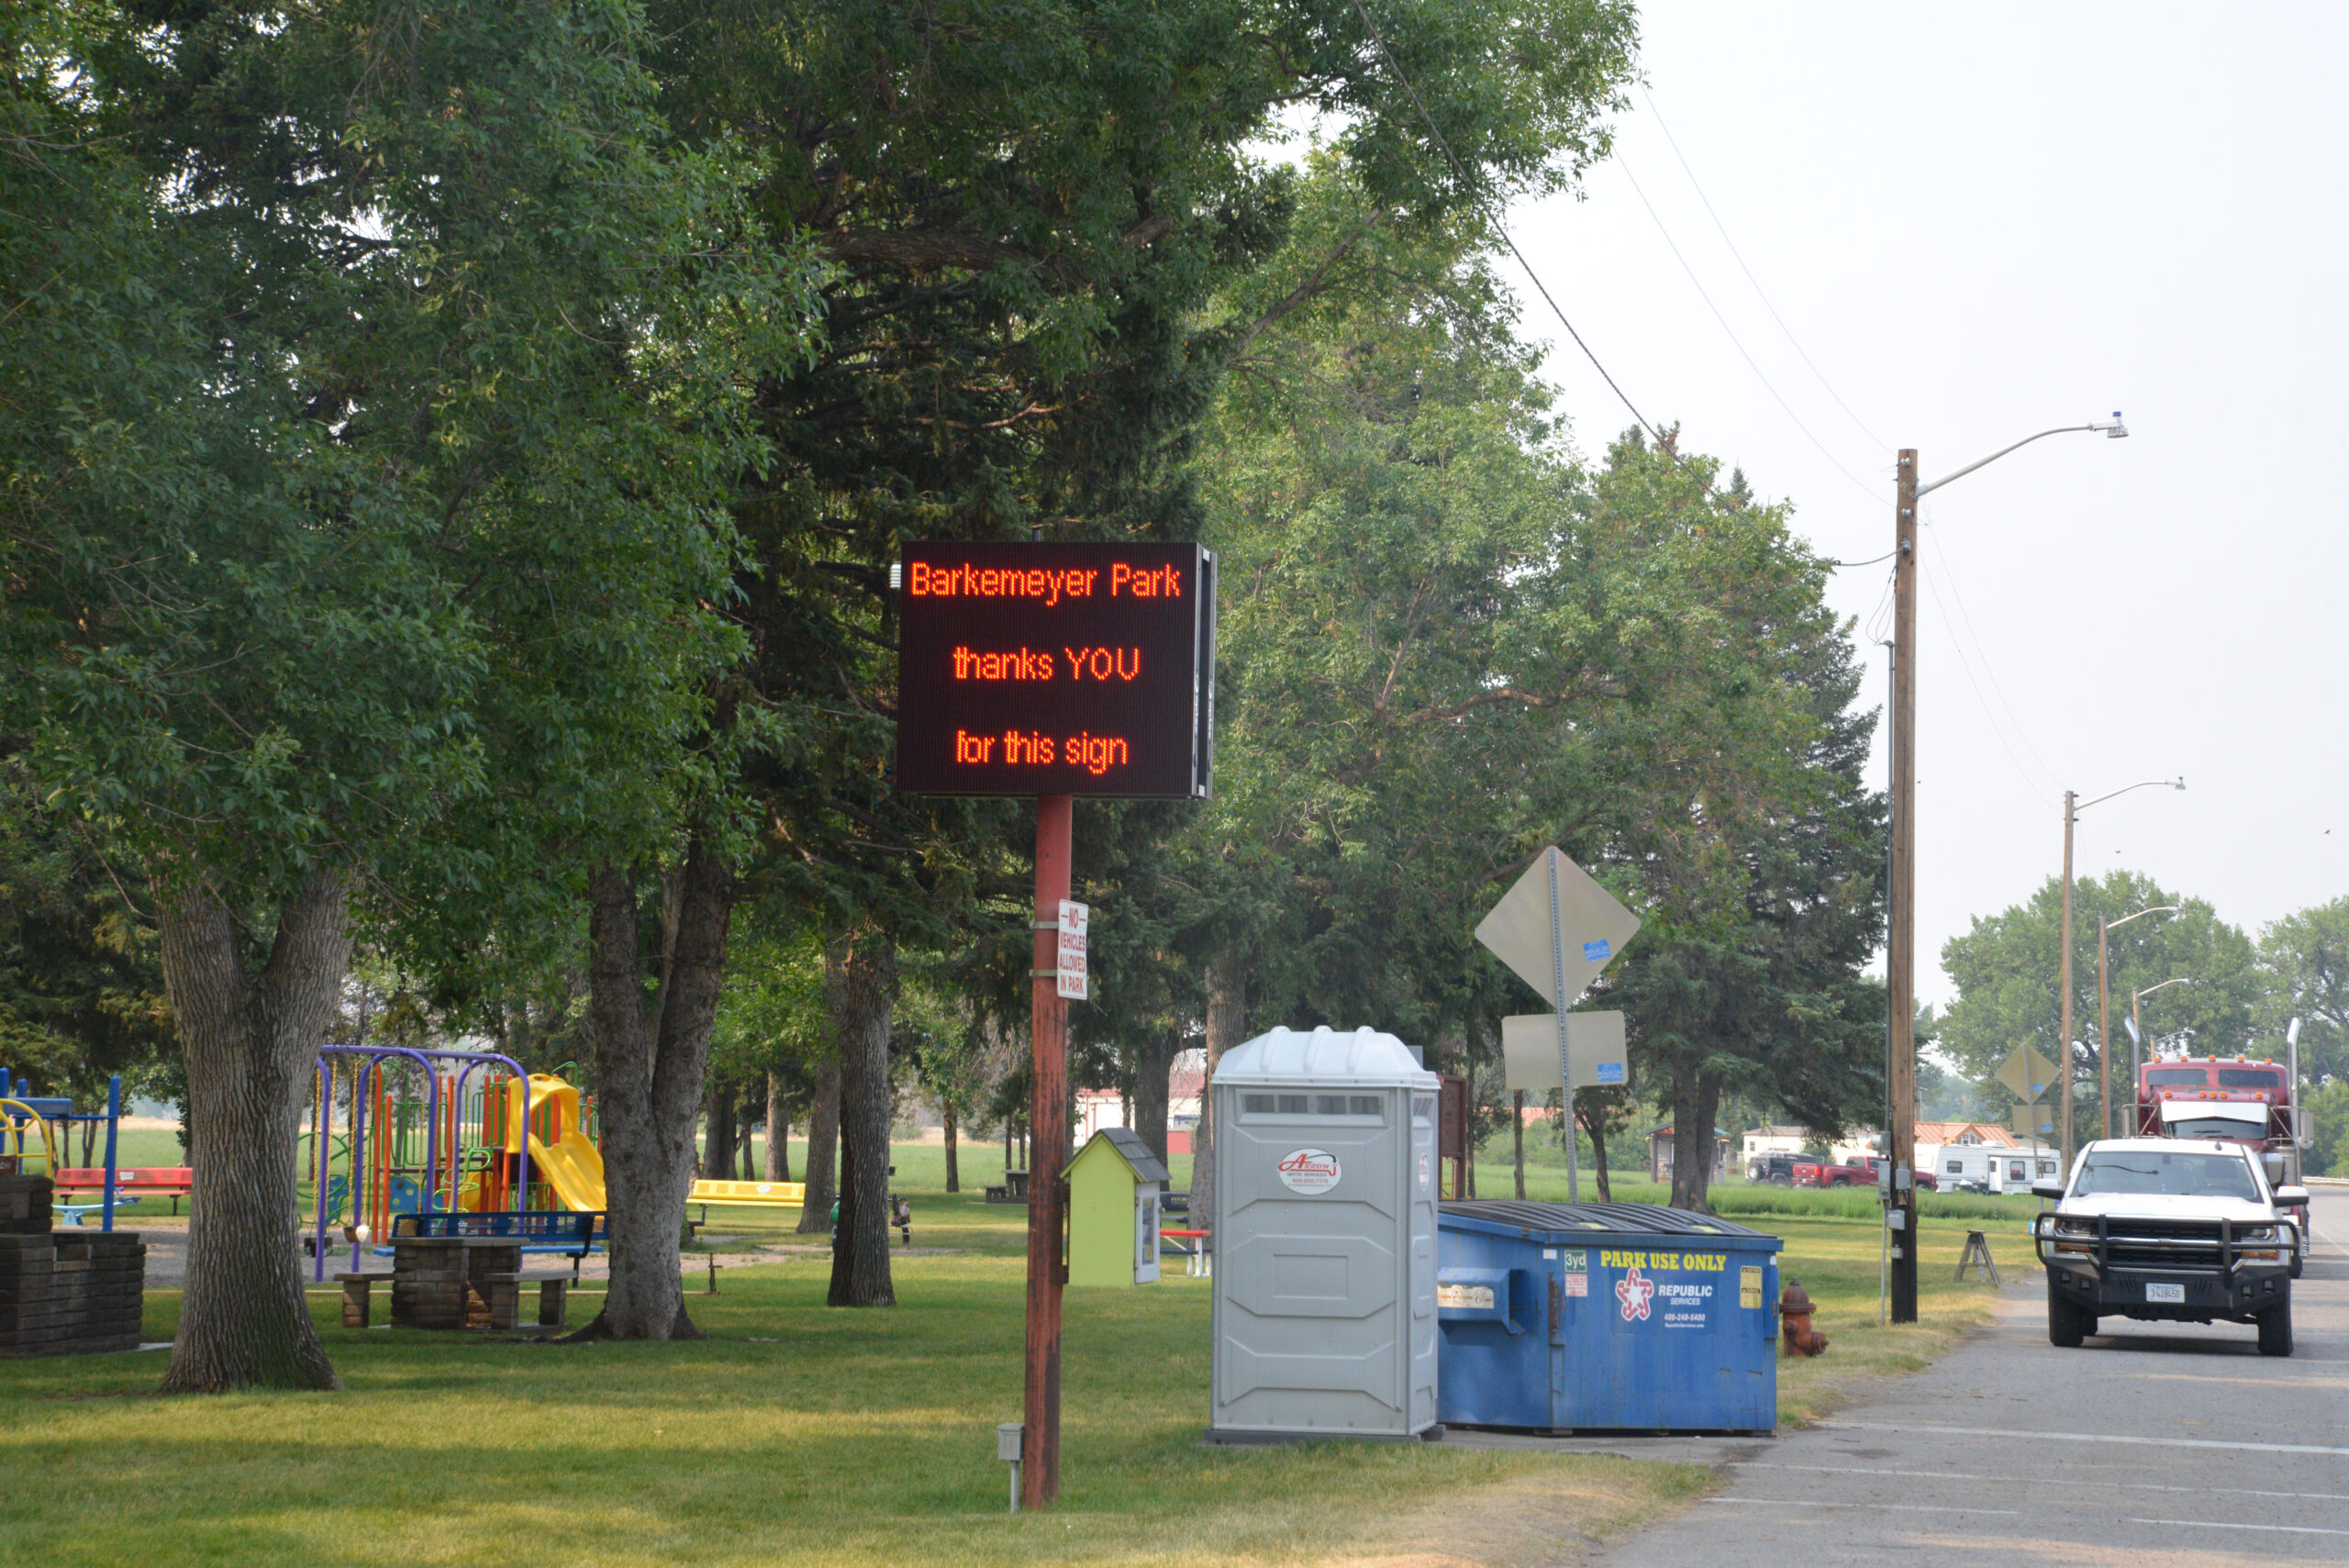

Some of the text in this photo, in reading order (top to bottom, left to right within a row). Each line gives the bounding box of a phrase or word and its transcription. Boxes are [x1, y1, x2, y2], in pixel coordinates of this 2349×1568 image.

[910, 562, 1182, 606] Barkemeyer Park
[952, 646, 1141, 681] thanks YOU
[956, 729, 1129, 774] for this sign
[1060, 932, 1085, 952] VEHICLES
[1059, 953, 1085, 973] ALLOWED
[1060, 974, 1085, 994] IN PARK
[1565, 1253, 1586, 1270] 3yd
[1600, 1250, 1727, 1272] PARK USE ONLY
[1658, 1284, 1713, 1297] REPUBLIC
[1670, 1297, 1701, 1306] SERVICES
